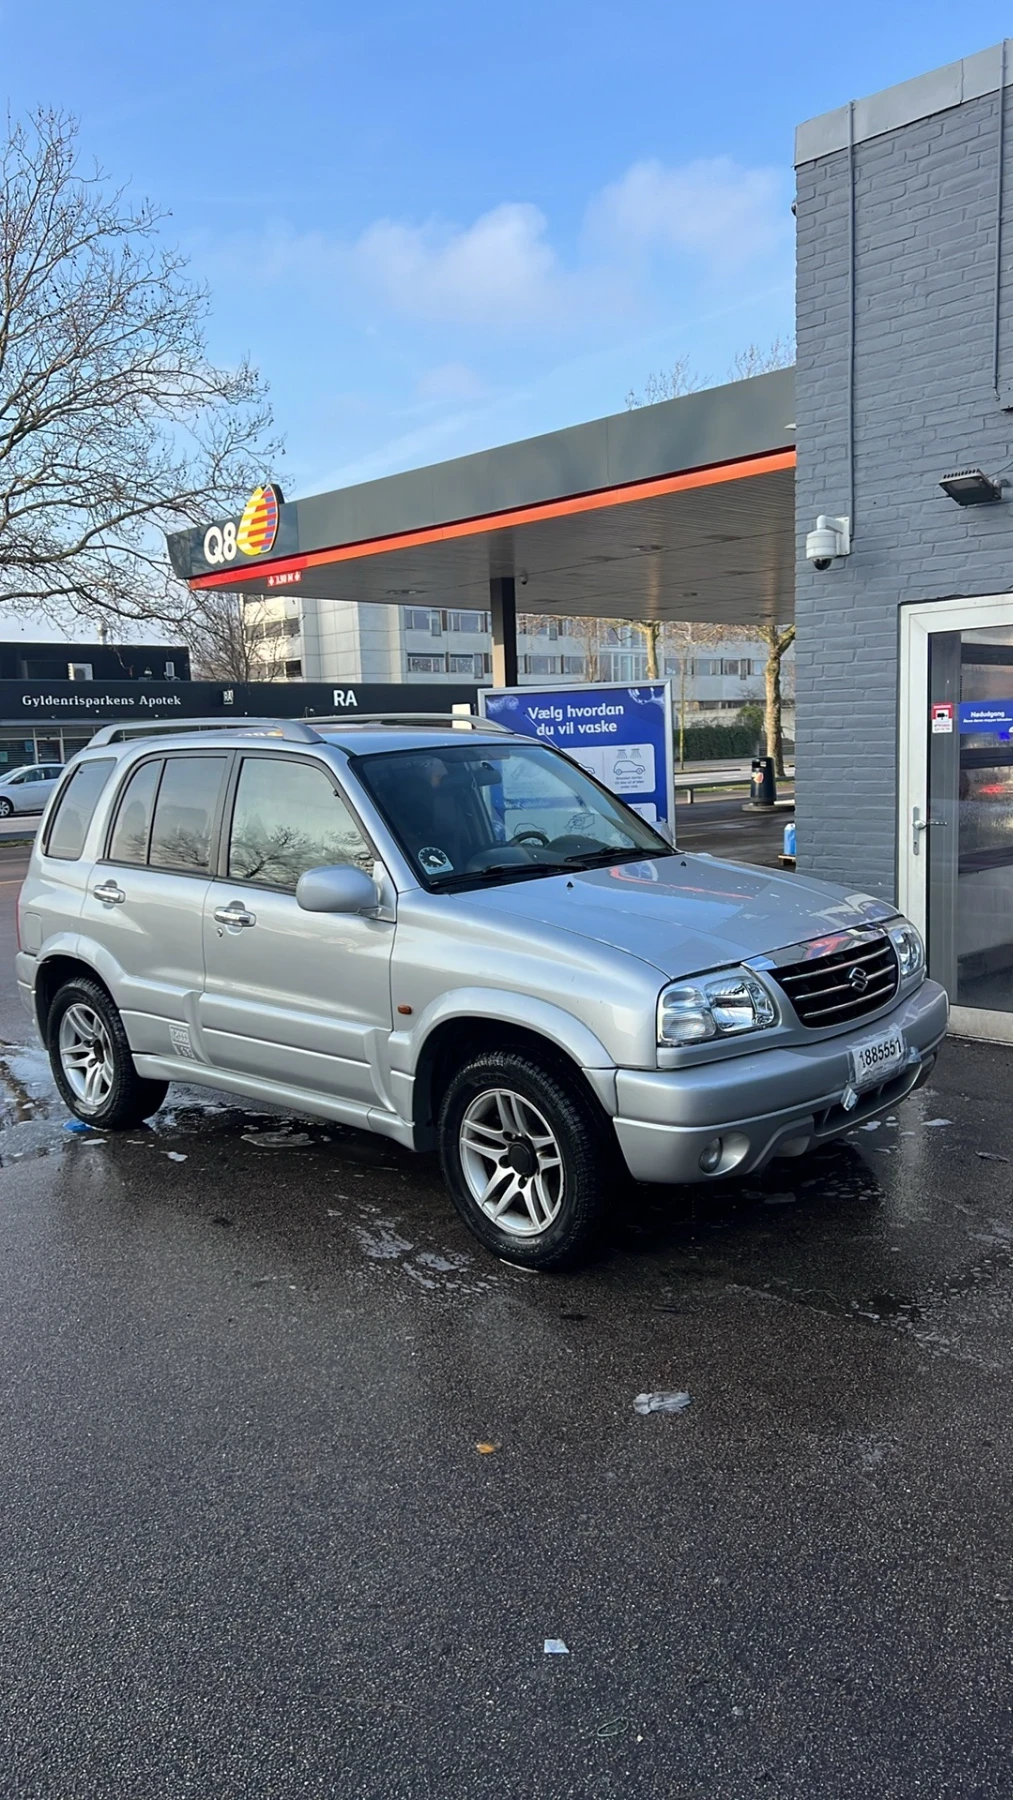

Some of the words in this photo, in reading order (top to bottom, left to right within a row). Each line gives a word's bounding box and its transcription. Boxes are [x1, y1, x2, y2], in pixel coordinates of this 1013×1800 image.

[204, 522, 237, 564] Q8
[23, 695, 135, 707] Gyldenrisparkens
[139, 695, 181, 707] Apotek
[333, 689, 358, 707] RA
[527, 706, 563, 721] Vælg
[567, 703, 624, 717] hvordan
[536, 723, 555, 736] du
[558, 722, 574, 734] vil
[578, 720, 617, 733] vaske
